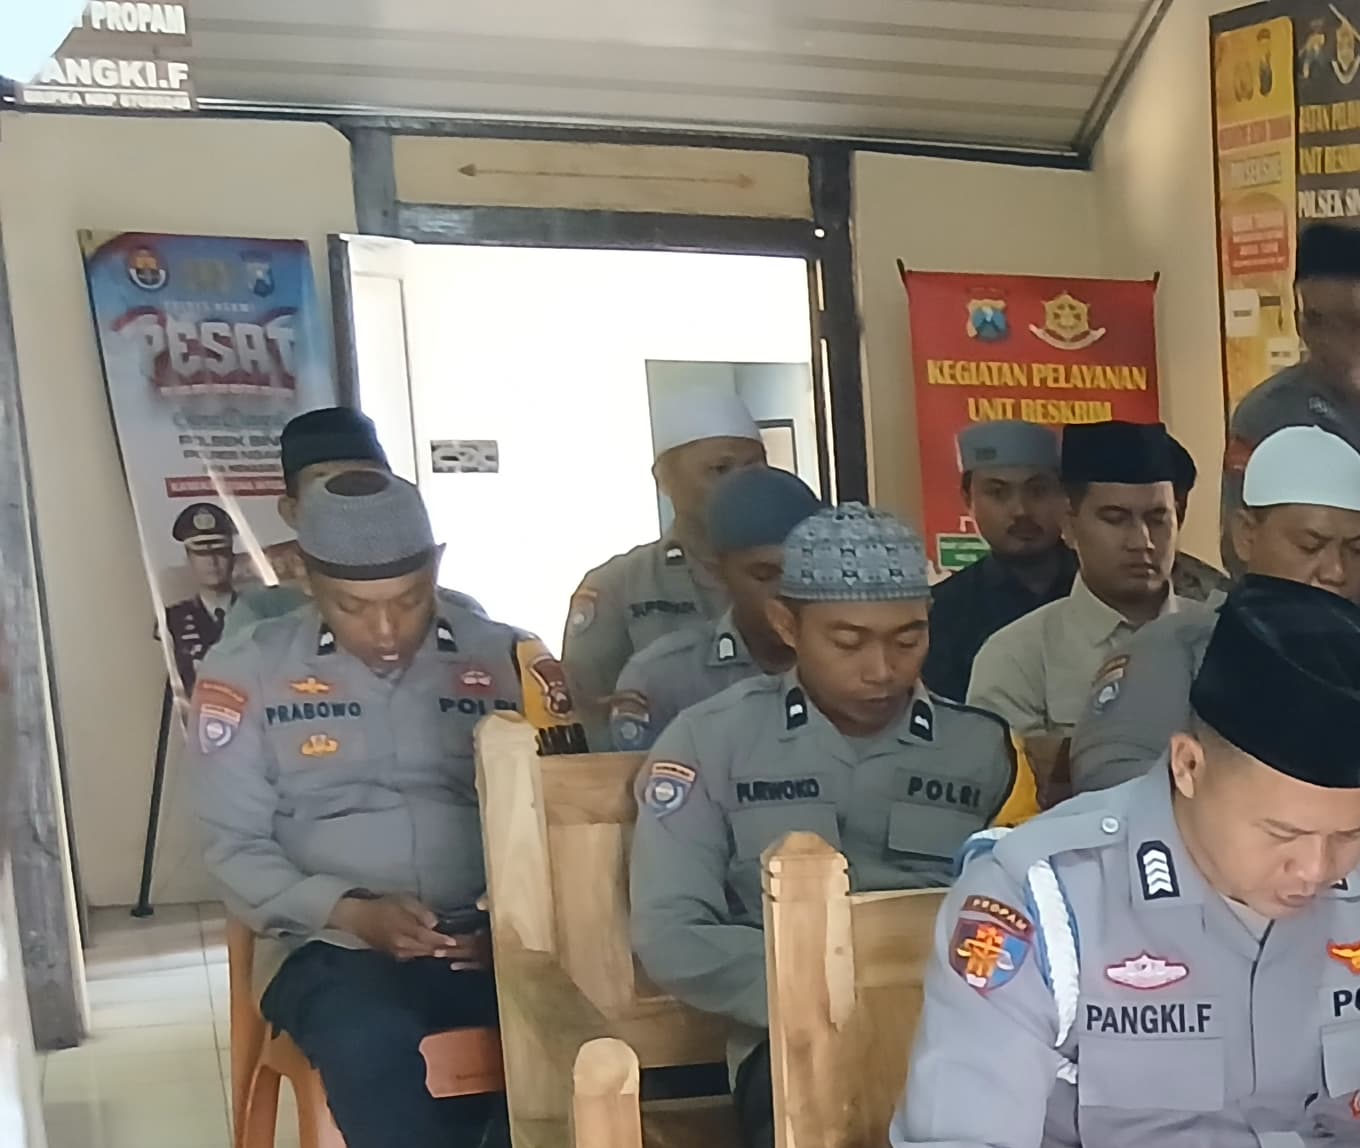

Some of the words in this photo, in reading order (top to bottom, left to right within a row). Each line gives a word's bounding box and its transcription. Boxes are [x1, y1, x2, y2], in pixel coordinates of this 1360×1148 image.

[90, 1, 186, 34] PROPAM
[38, 57, 190, 89] ANGKI.F
[120, 312, 298, 382] PESAT
[927, 359, 1027, 386] KEGIATAN
[1031, 363, 1147, 390] PELAYANAN
[968, 397, 1015, 421] UNIT
[265, 702, 362, 725] PRABOWO
[908, 776, 980, 808] POLRI
[1086, 1002, 1212, 1034] PANGKI.F
